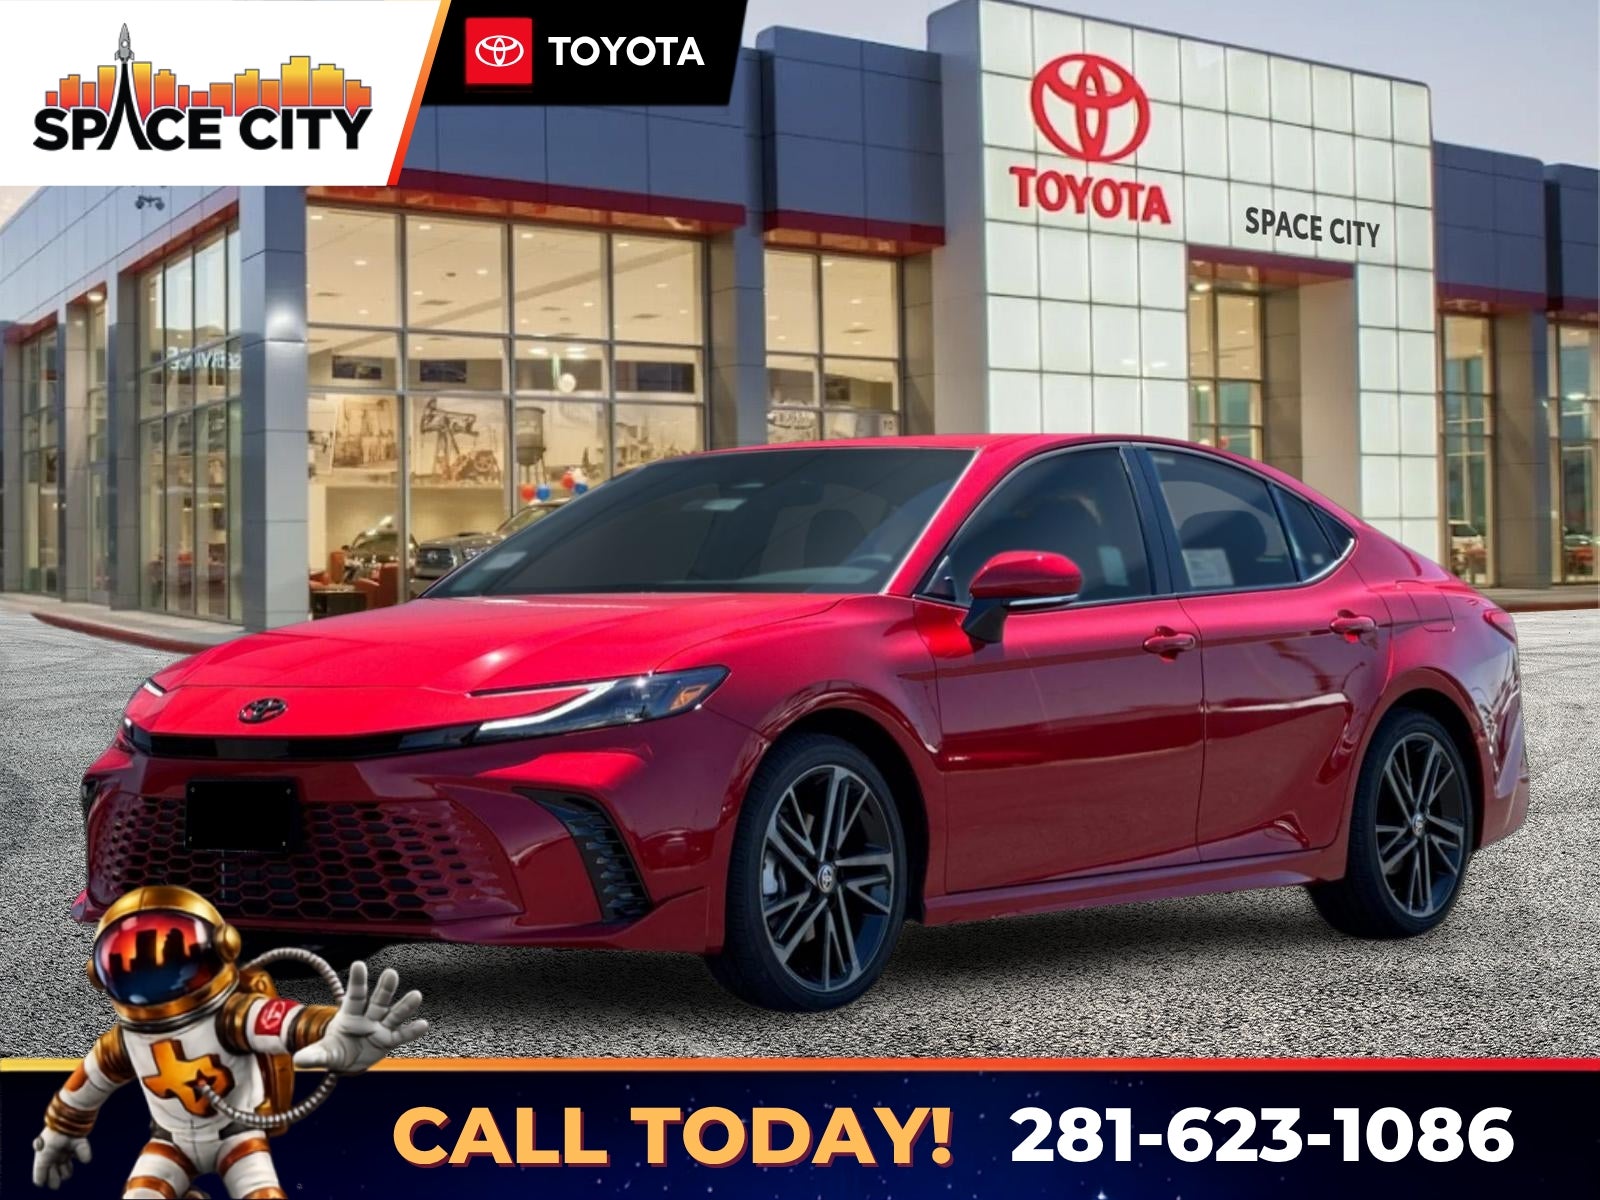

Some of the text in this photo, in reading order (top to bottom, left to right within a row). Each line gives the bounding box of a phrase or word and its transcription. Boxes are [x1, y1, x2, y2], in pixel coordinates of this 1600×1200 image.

[1010, 165, 1171, 224] TOYOTA
[1245, 206, 1381, 248] SPACE CITY
